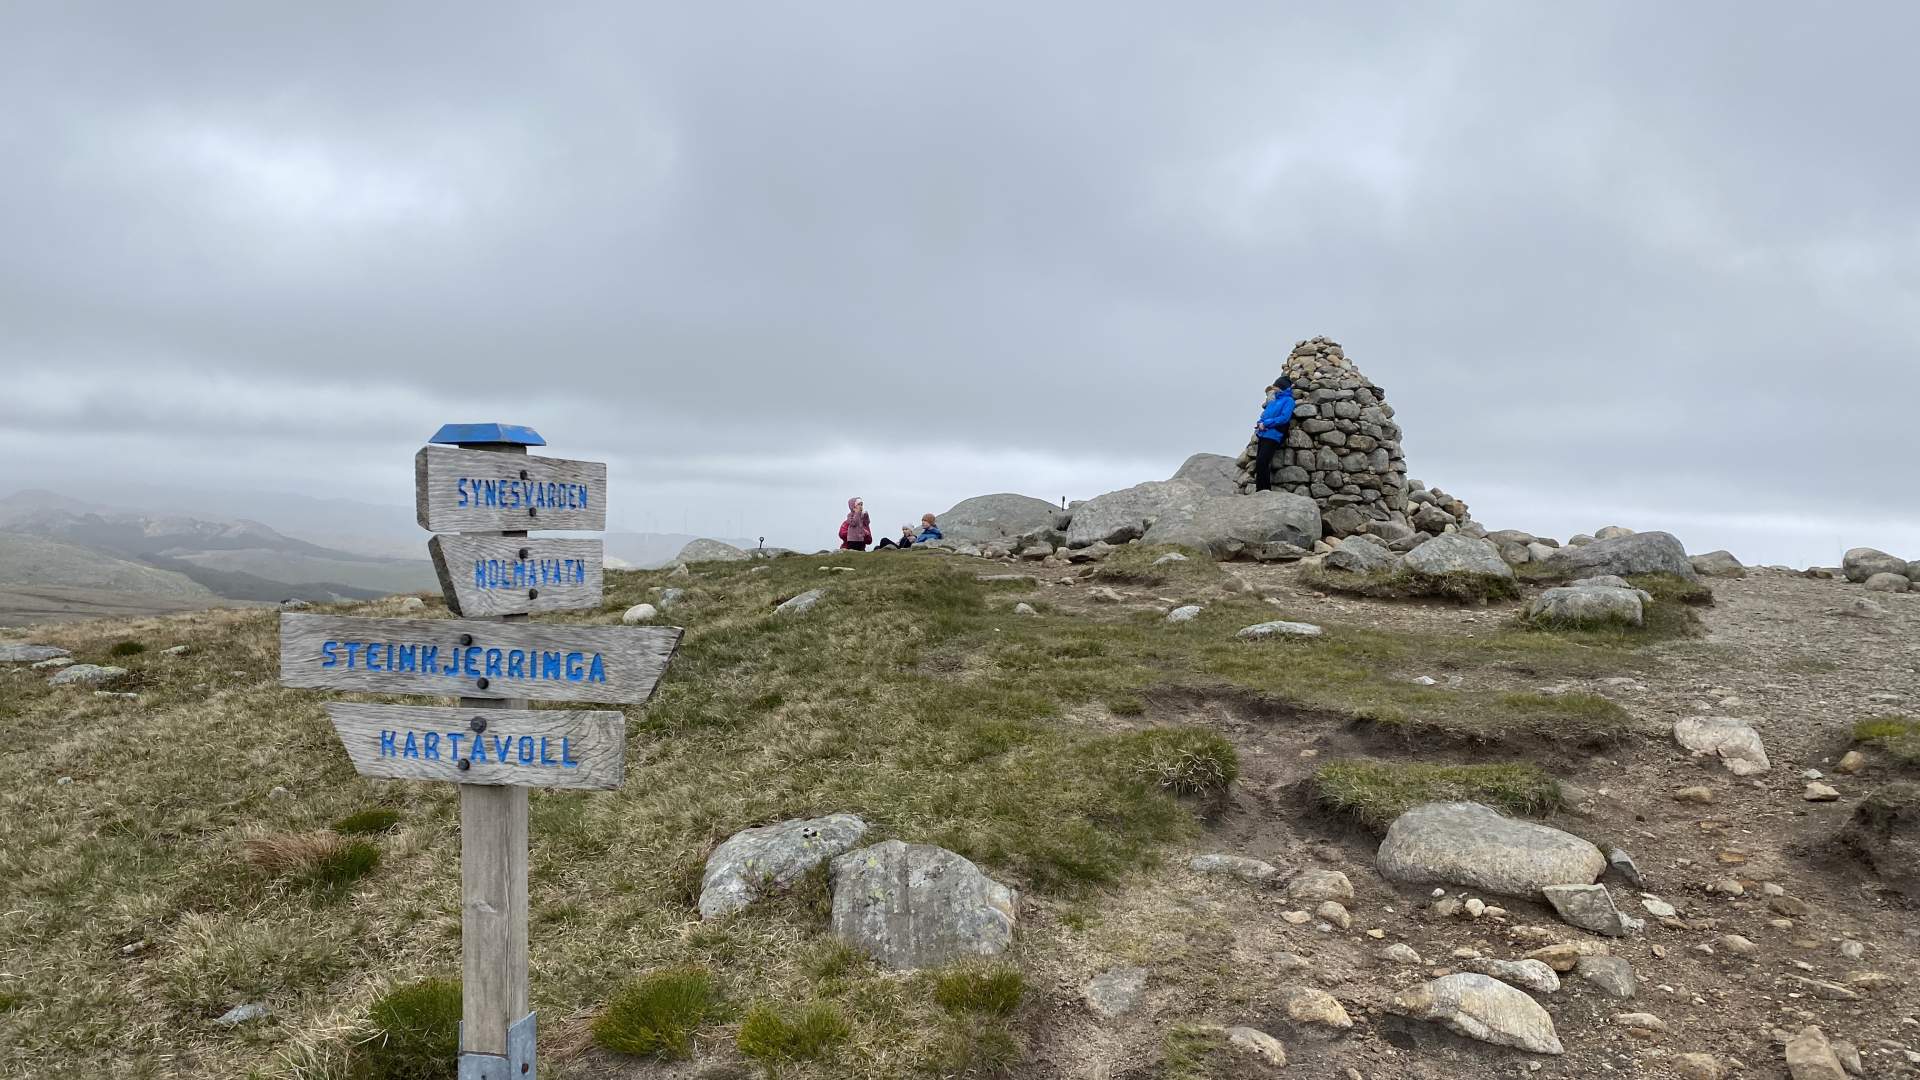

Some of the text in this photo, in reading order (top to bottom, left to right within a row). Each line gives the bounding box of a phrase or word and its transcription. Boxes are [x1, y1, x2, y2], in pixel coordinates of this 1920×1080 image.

[458, 478, 588, 509] SYNESVARDEN
[476, 559, 585, 589] HOLMAVATN
[322, 641, 606, 683] STEINKJERRINGA
[380, 729, 577, 768] KARTAVOLL
